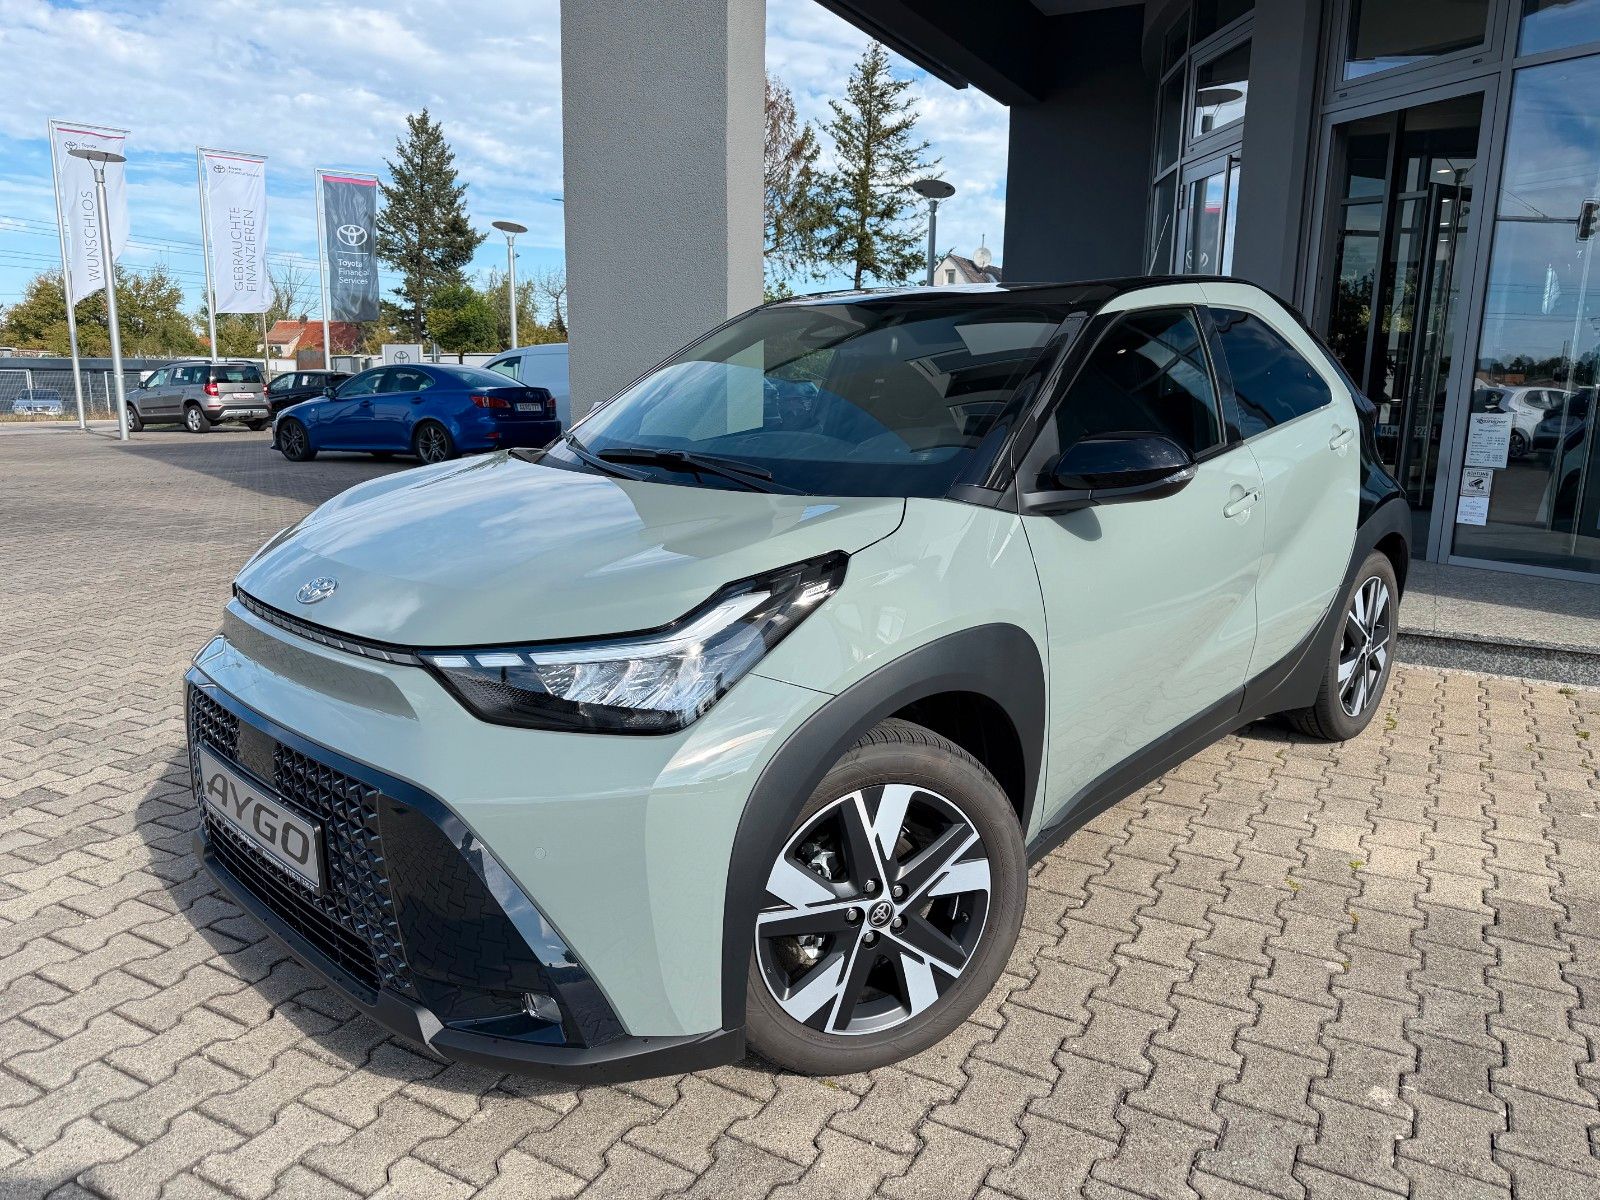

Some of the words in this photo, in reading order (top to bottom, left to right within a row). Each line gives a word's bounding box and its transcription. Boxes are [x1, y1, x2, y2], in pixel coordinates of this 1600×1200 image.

[81, 191, 100, 286] WUNSCHLOS
[229, 207, 244, 291] GEBRAUCHTE
[243, 209, 257, 292] FINANZIEREN
[337, 258, 363, 268] Toyota
[338, 267, 370, 277] Financal
[338, 276, 369, 285] Services
[206, 773, 310, 866] AYGO
